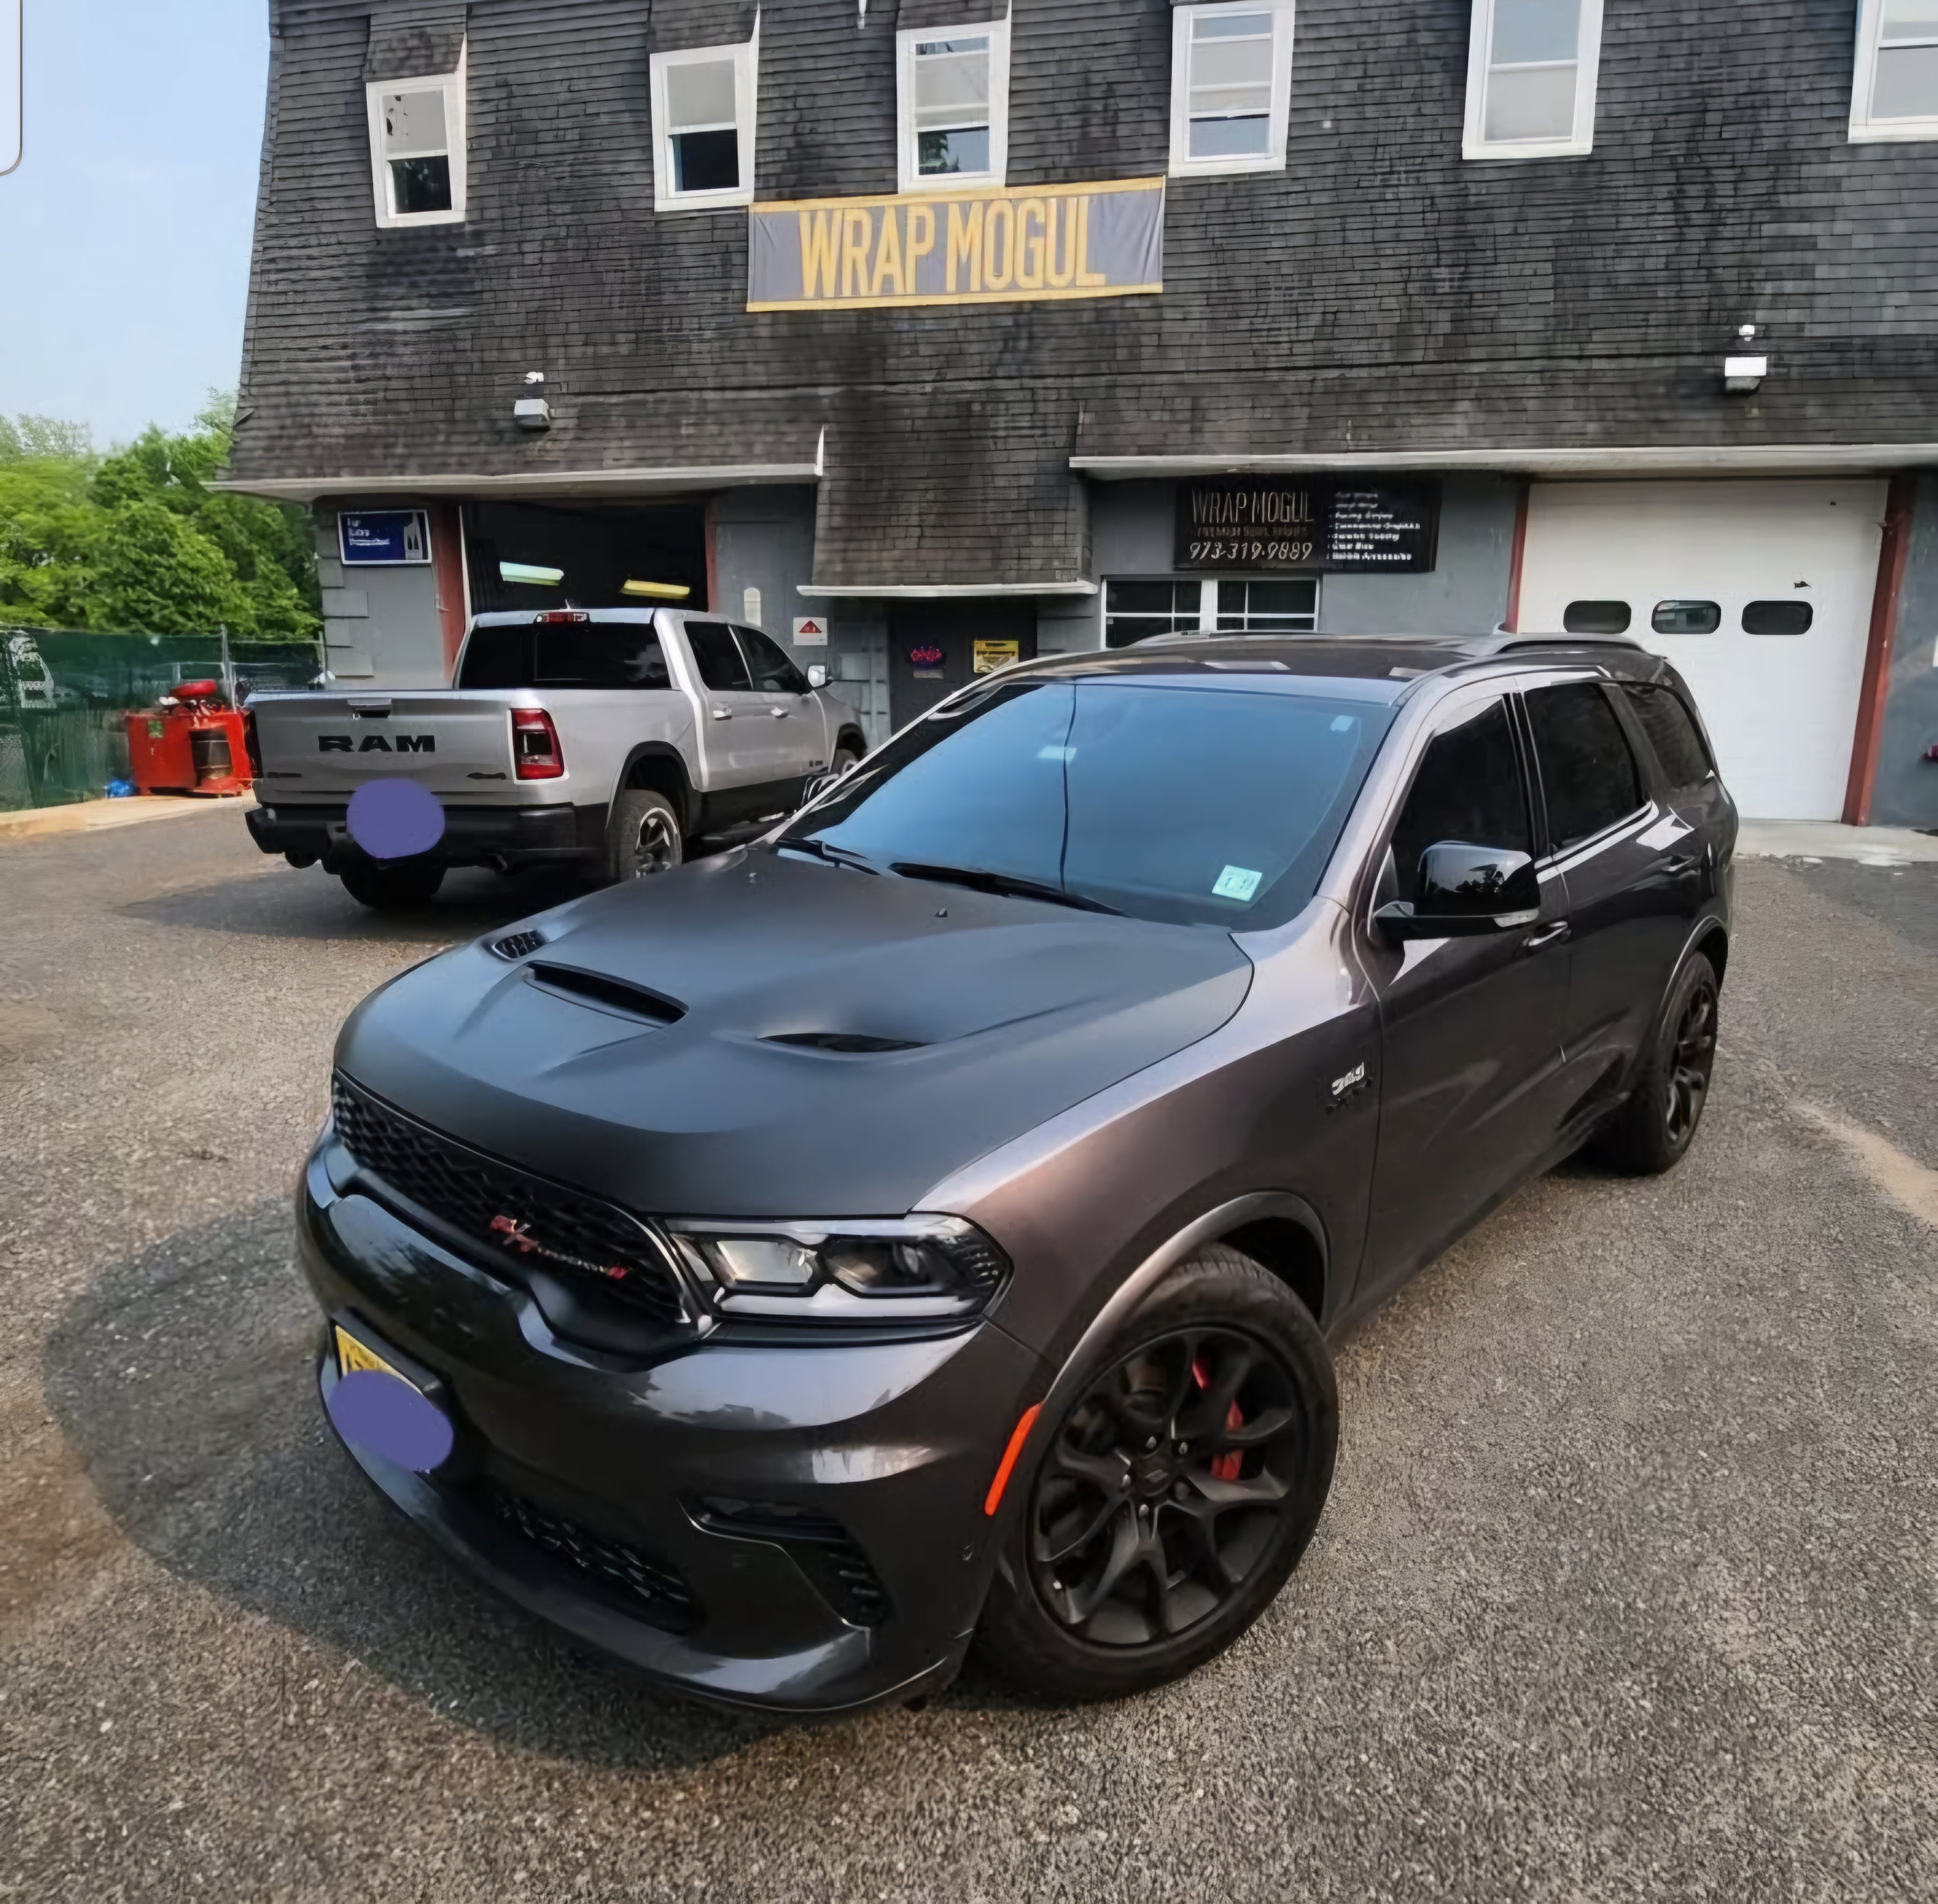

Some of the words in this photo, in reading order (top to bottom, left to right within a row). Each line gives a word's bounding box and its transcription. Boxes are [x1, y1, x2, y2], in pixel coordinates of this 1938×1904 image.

[799, 205, 935, 298] WRAP
[946, 195, 1107, 292] MOGUL
[1192, 489, 1247, 524] WRAP
[1251, 490, 1314, 524] MOGUL
[318, 735, 435, 752] RAM
